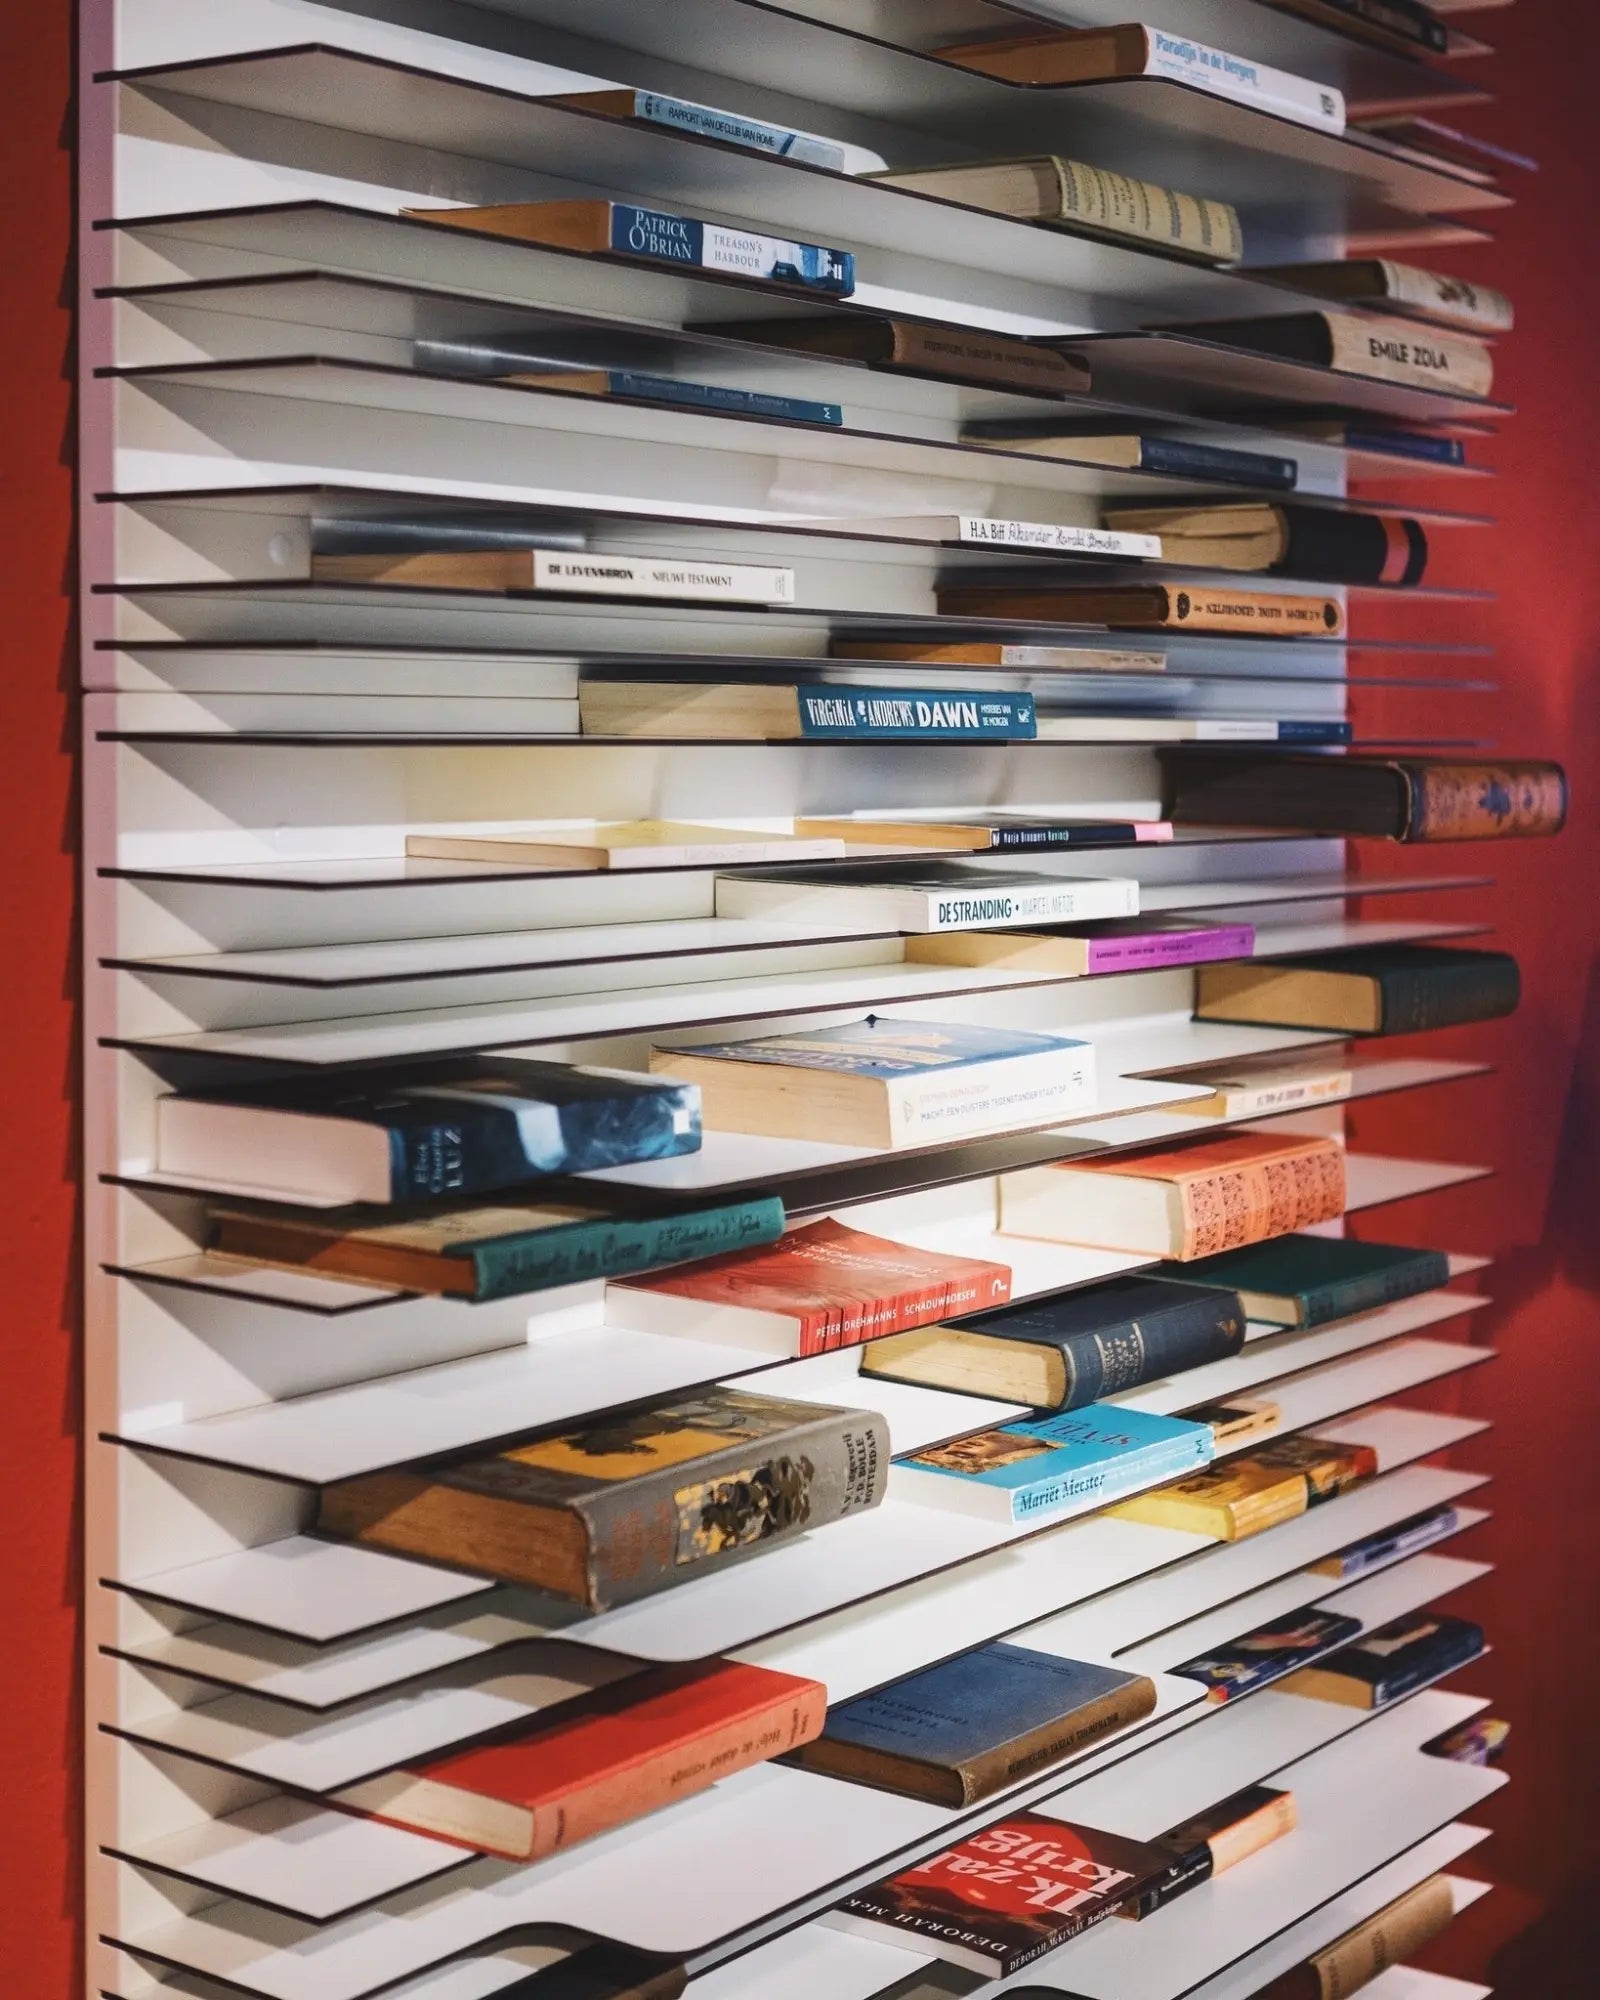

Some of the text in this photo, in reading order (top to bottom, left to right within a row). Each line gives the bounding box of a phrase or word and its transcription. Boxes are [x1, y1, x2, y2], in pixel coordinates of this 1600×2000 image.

[1210, 52, 1222, 69] de
[668, 106, 775, 147] RAPPORT VAN DE CLUB VAN ROME
[635, 209, 688, 242] PATRICK
[628, 225, 693, 260] O'BRIAN
[713, 233, 763, 254] TREASON'S
[714, 251, 761, 269] HARBOUR
[1368, 338, 1449, 371] EMILE ZOLA
[549, 564, 561, 576] DE
[652, 571, 686, 584] NIEUWE
[688, 572, 733, 587] TESTAMENT
[867, 699, 915, 728] ANDREWS
[916, 701, 980, 728] DAWN
[938, 901, 952, 924] DE
[952, 898, 1013, 923] STRANDING
[815, 1288, 977, 1338] PETER DREHMANNS SCHADUWBOKSEN
[863, 1428, 877, 1505] ROTTERDAM
[1020, 1473, 1106, 1513] Mariët Meester
[968, 1830, 1135, 1894] krijg
[911, 1851, 1103, 1916] Ik zal
[845, 1898, 1009, 1953] DEBORAH McK
[1009, 1941, 1048, 1971] DEBORAH
